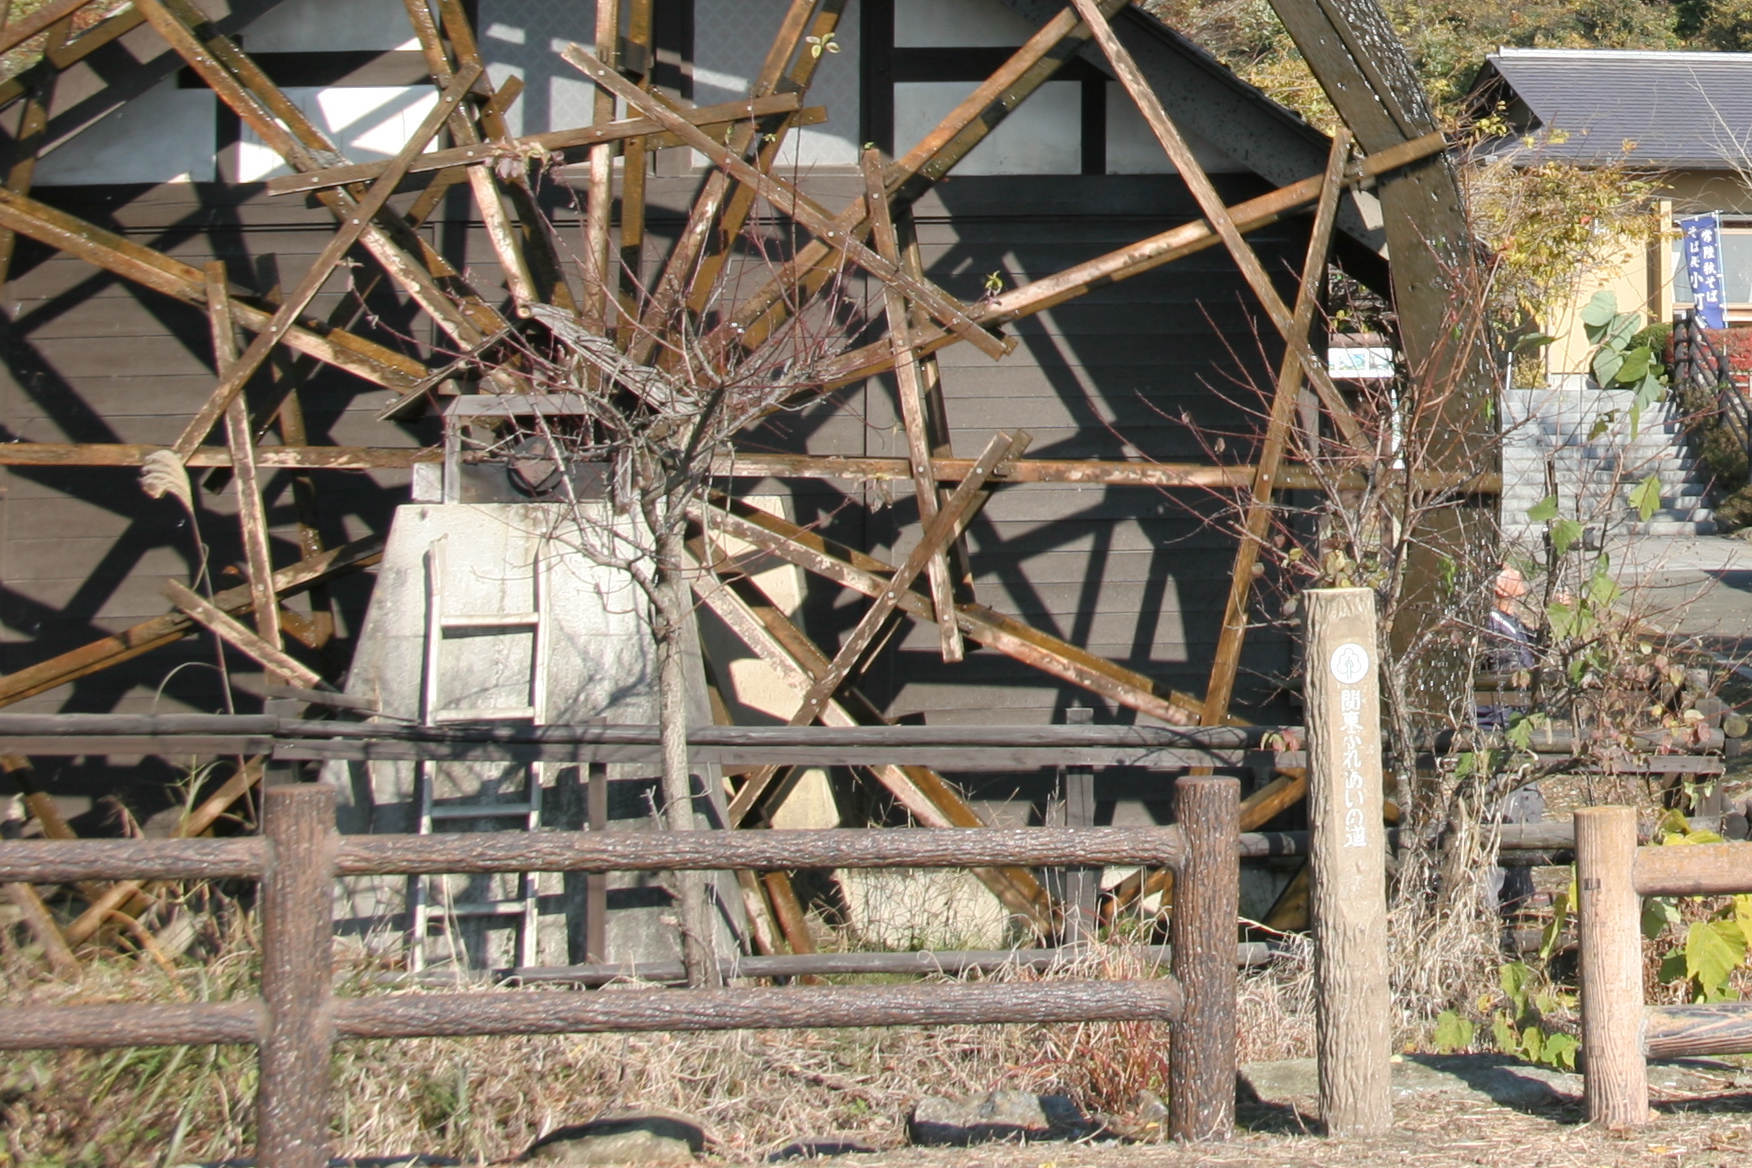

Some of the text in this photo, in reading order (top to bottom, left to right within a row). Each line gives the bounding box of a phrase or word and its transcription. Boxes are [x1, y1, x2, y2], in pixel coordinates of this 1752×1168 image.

[1701, 228, 1718, 303] 常陸秋そば
[1340, 689, 1366, 847] 関東ふれあいの道
